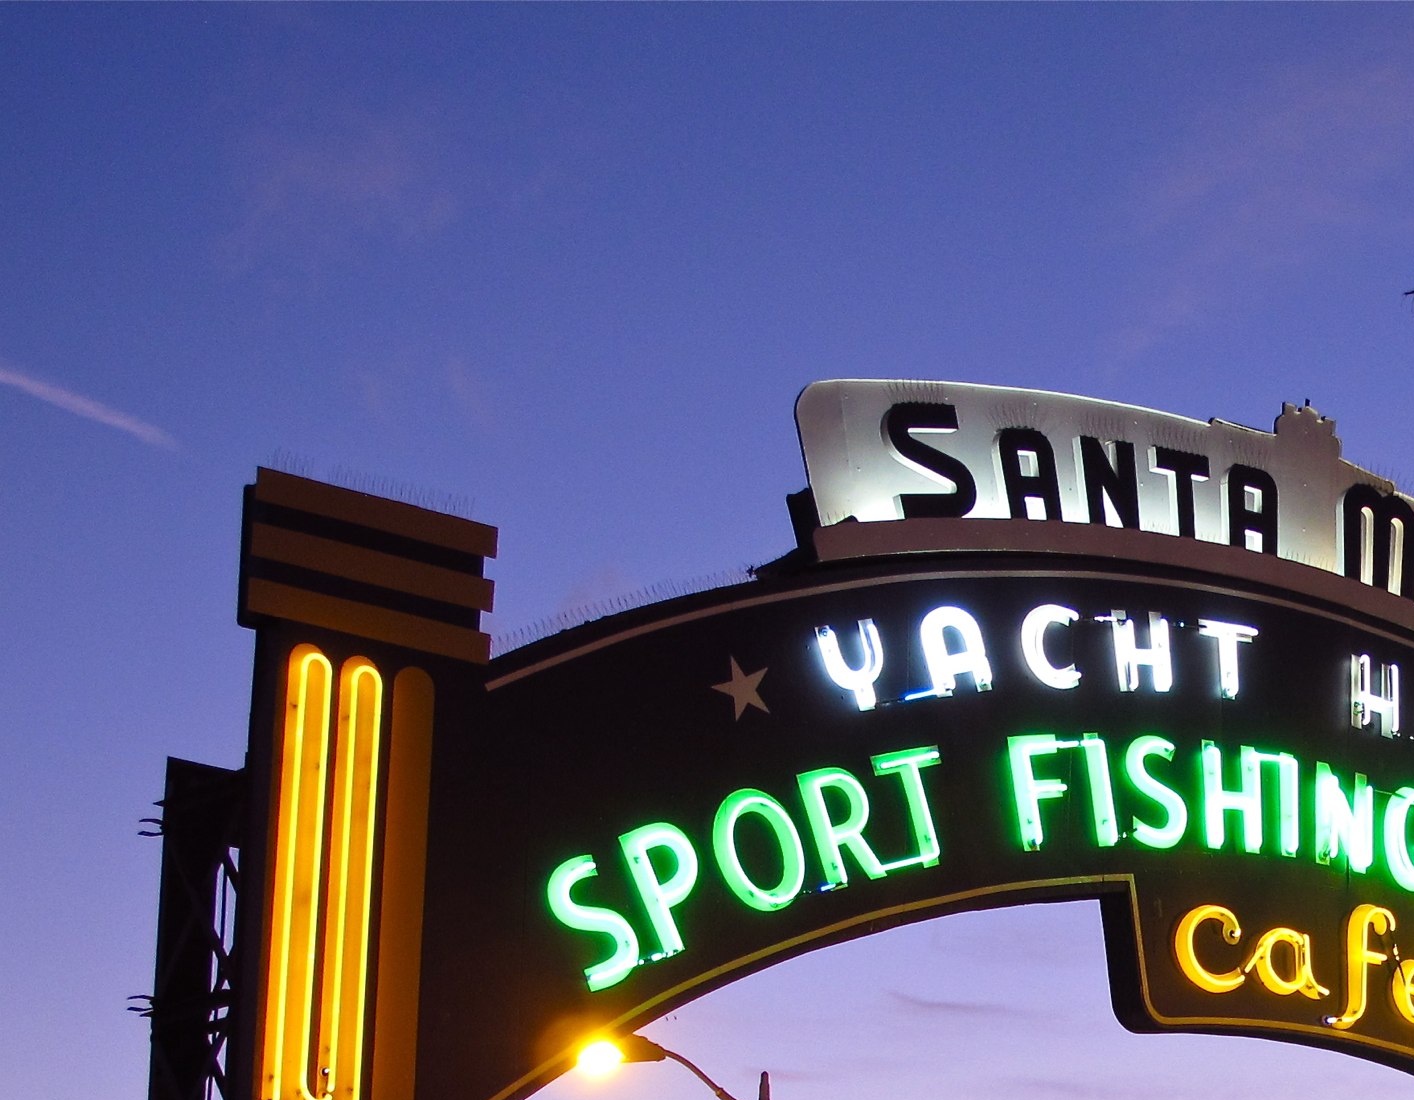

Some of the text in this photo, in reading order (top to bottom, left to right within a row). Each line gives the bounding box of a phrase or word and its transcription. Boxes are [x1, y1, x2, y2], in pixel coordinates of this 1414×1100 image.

[881, 402, 1278, 554] SANTA
[815, 604, 1260, 711] YACHT
[547, 745, 942, 992] SPORT
